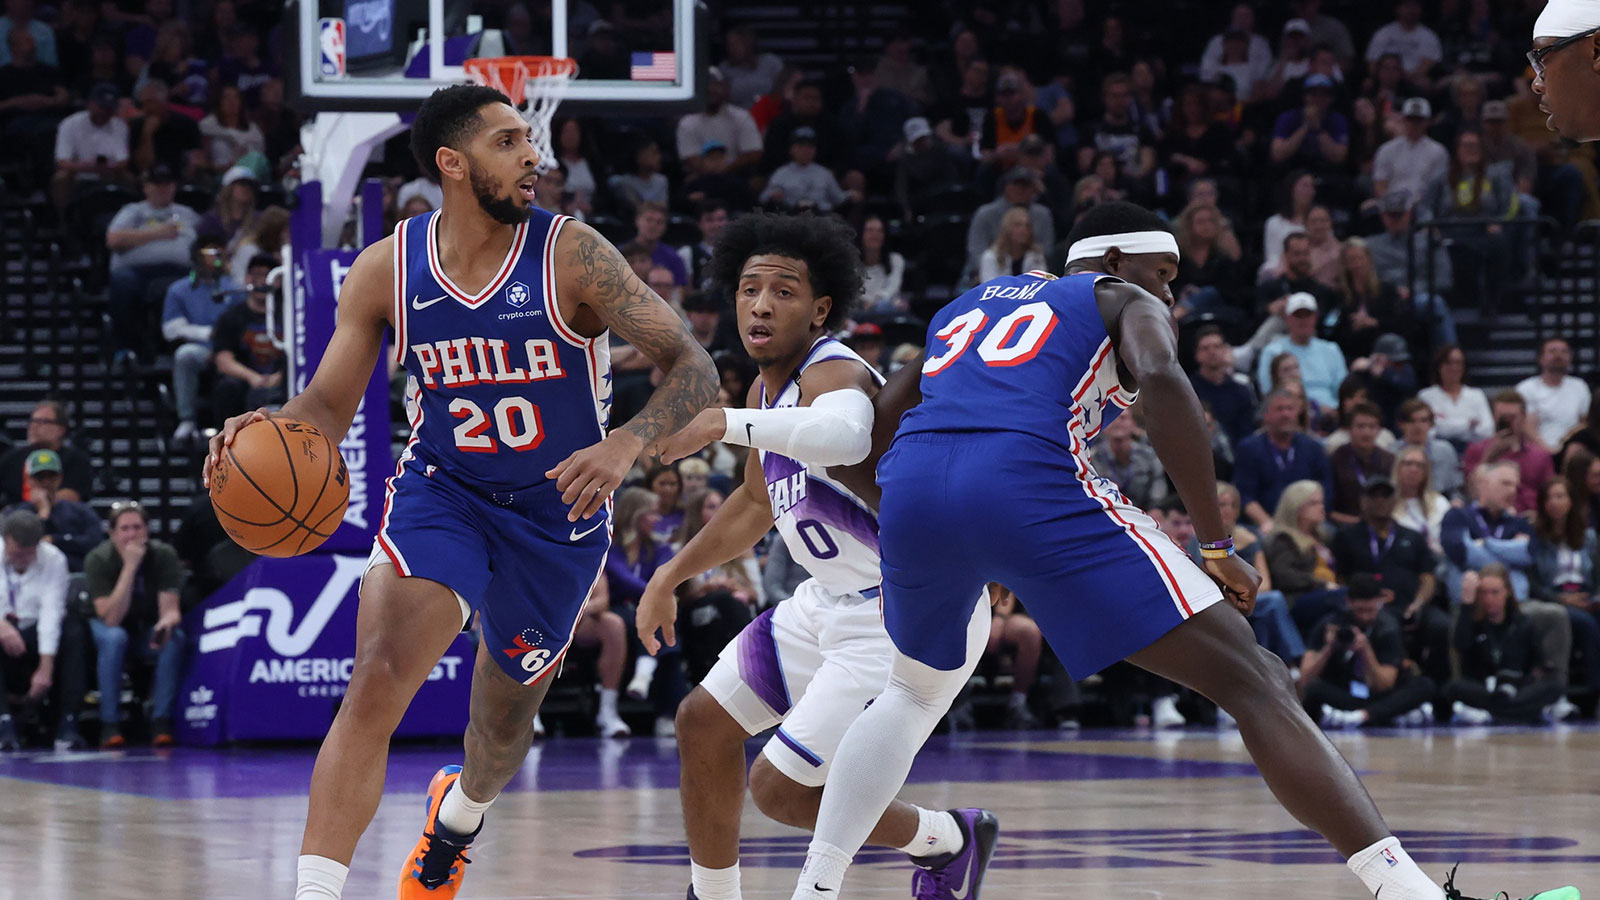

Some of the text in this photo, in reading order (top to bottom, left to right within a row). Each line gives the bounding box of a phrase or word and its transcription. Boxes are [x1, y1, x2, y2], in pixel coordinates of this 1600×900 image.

[498, 310, 543, 321] crypto.com
[921, 301, 1060, 378] 30
[411, 336, 567, 390] PHILA
[449, 396, 546, 453] 20
[767, 468, 807, 520] AH
[796, 519, 839, 560] 0
[249, 657, 356, 683] AMERIC
